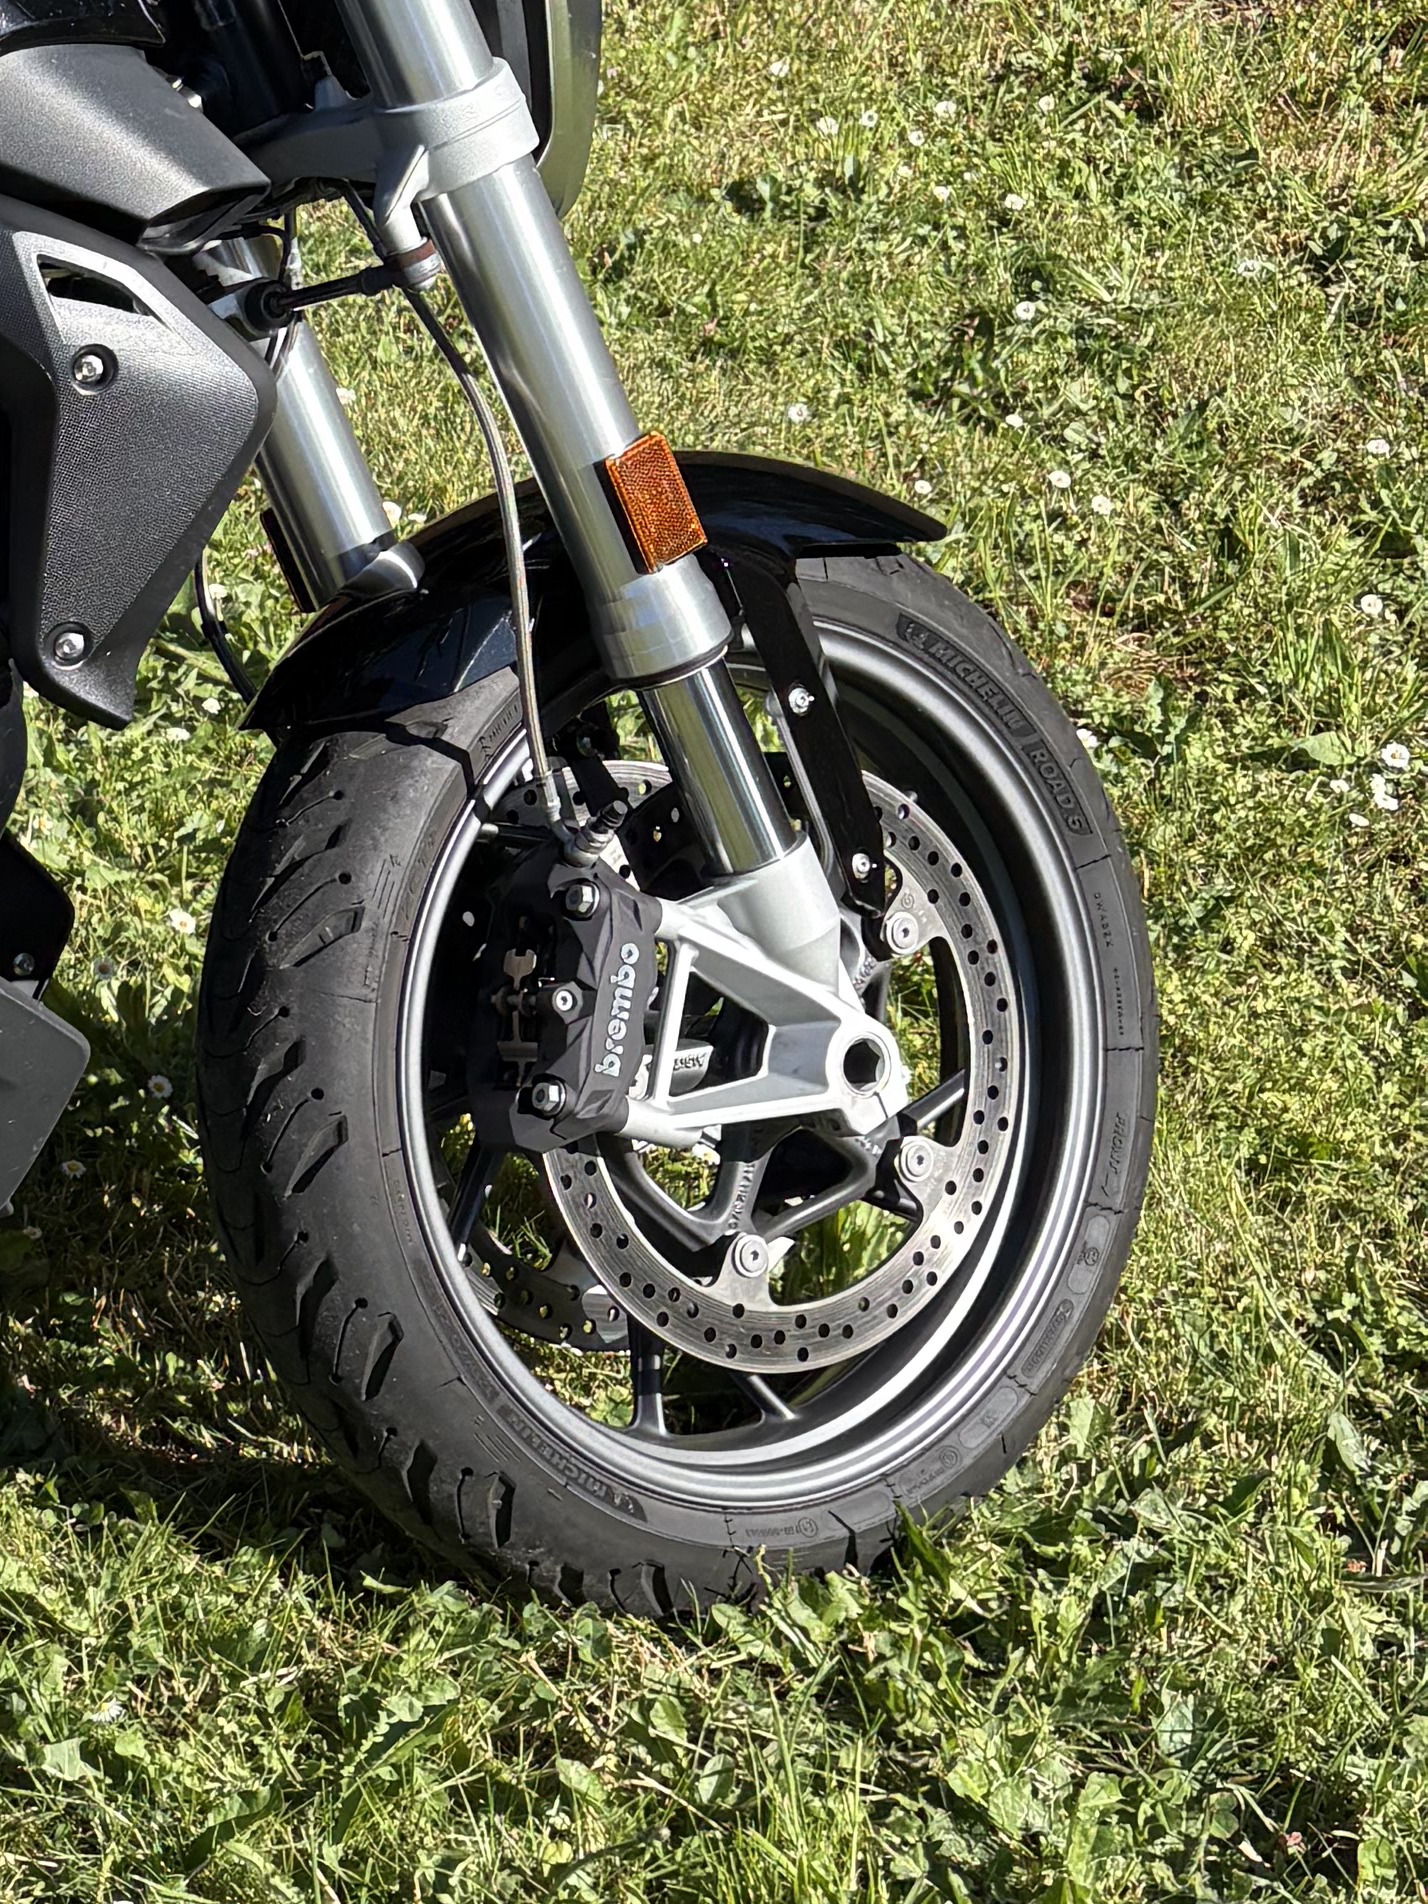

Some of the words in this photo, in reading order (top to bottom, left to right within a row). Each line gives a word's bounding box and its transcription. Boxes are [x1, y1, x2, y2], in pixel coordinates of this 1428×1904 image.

[928, 644, 1025, 732] MICHELIN
[1028, 746, 1075, 810] ROAD
[594, 942, 640, 1078] brembo
[508, 1412, 608, 1497] MICHELIN
